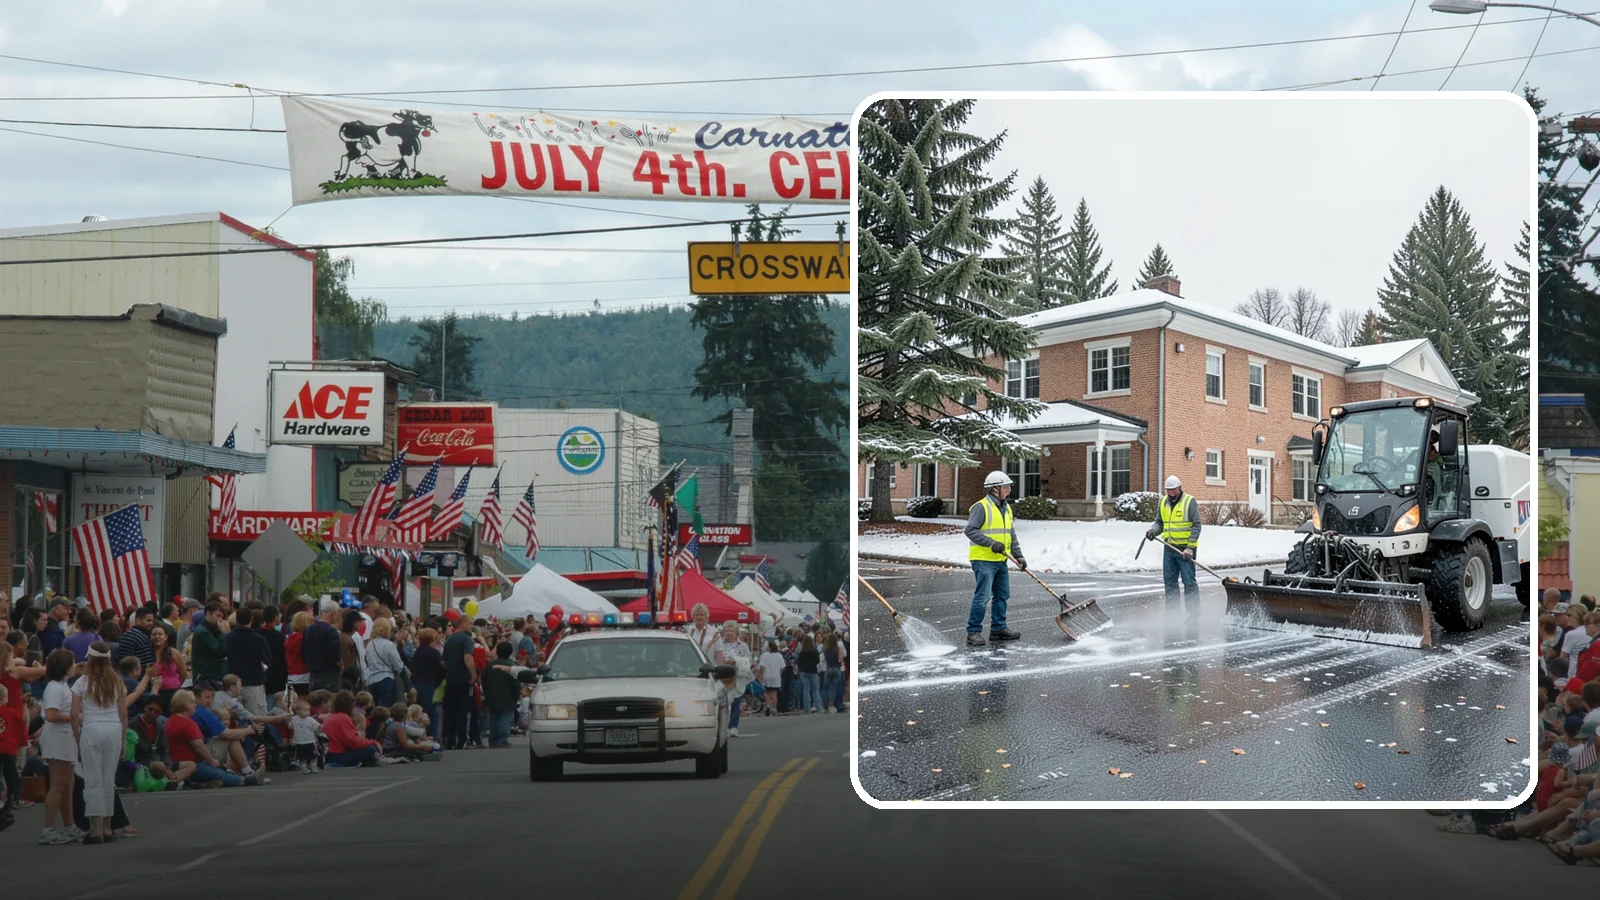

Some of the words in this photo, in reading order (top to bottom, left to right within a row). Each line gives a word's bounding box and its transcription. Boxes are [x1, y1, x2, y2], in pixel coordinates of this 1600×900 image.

[481, 141, 605, 192] JULY
[632, 150, 746, 198] 4th.
[697, 254, 850, 280] CROSSWA
[283, 380, 373, 420] ACE
[405, 409, 452, 421] CEDAR
[461, 409, 485, 421] LOG
[283, 421, 371, 436] Hardware
[416, 428, 476, 447] Coca-Cola
[353, 467, 386, 480] Simpl
[83, 484, 93, 494] St.
[95, 485, 124, 494] Vincent
[126, 486, 136, 495] de
[137, 486, 155, 495] Paul
[81, 503, 154, 522] THT
[688, 527, 741, 535] CRNATION
